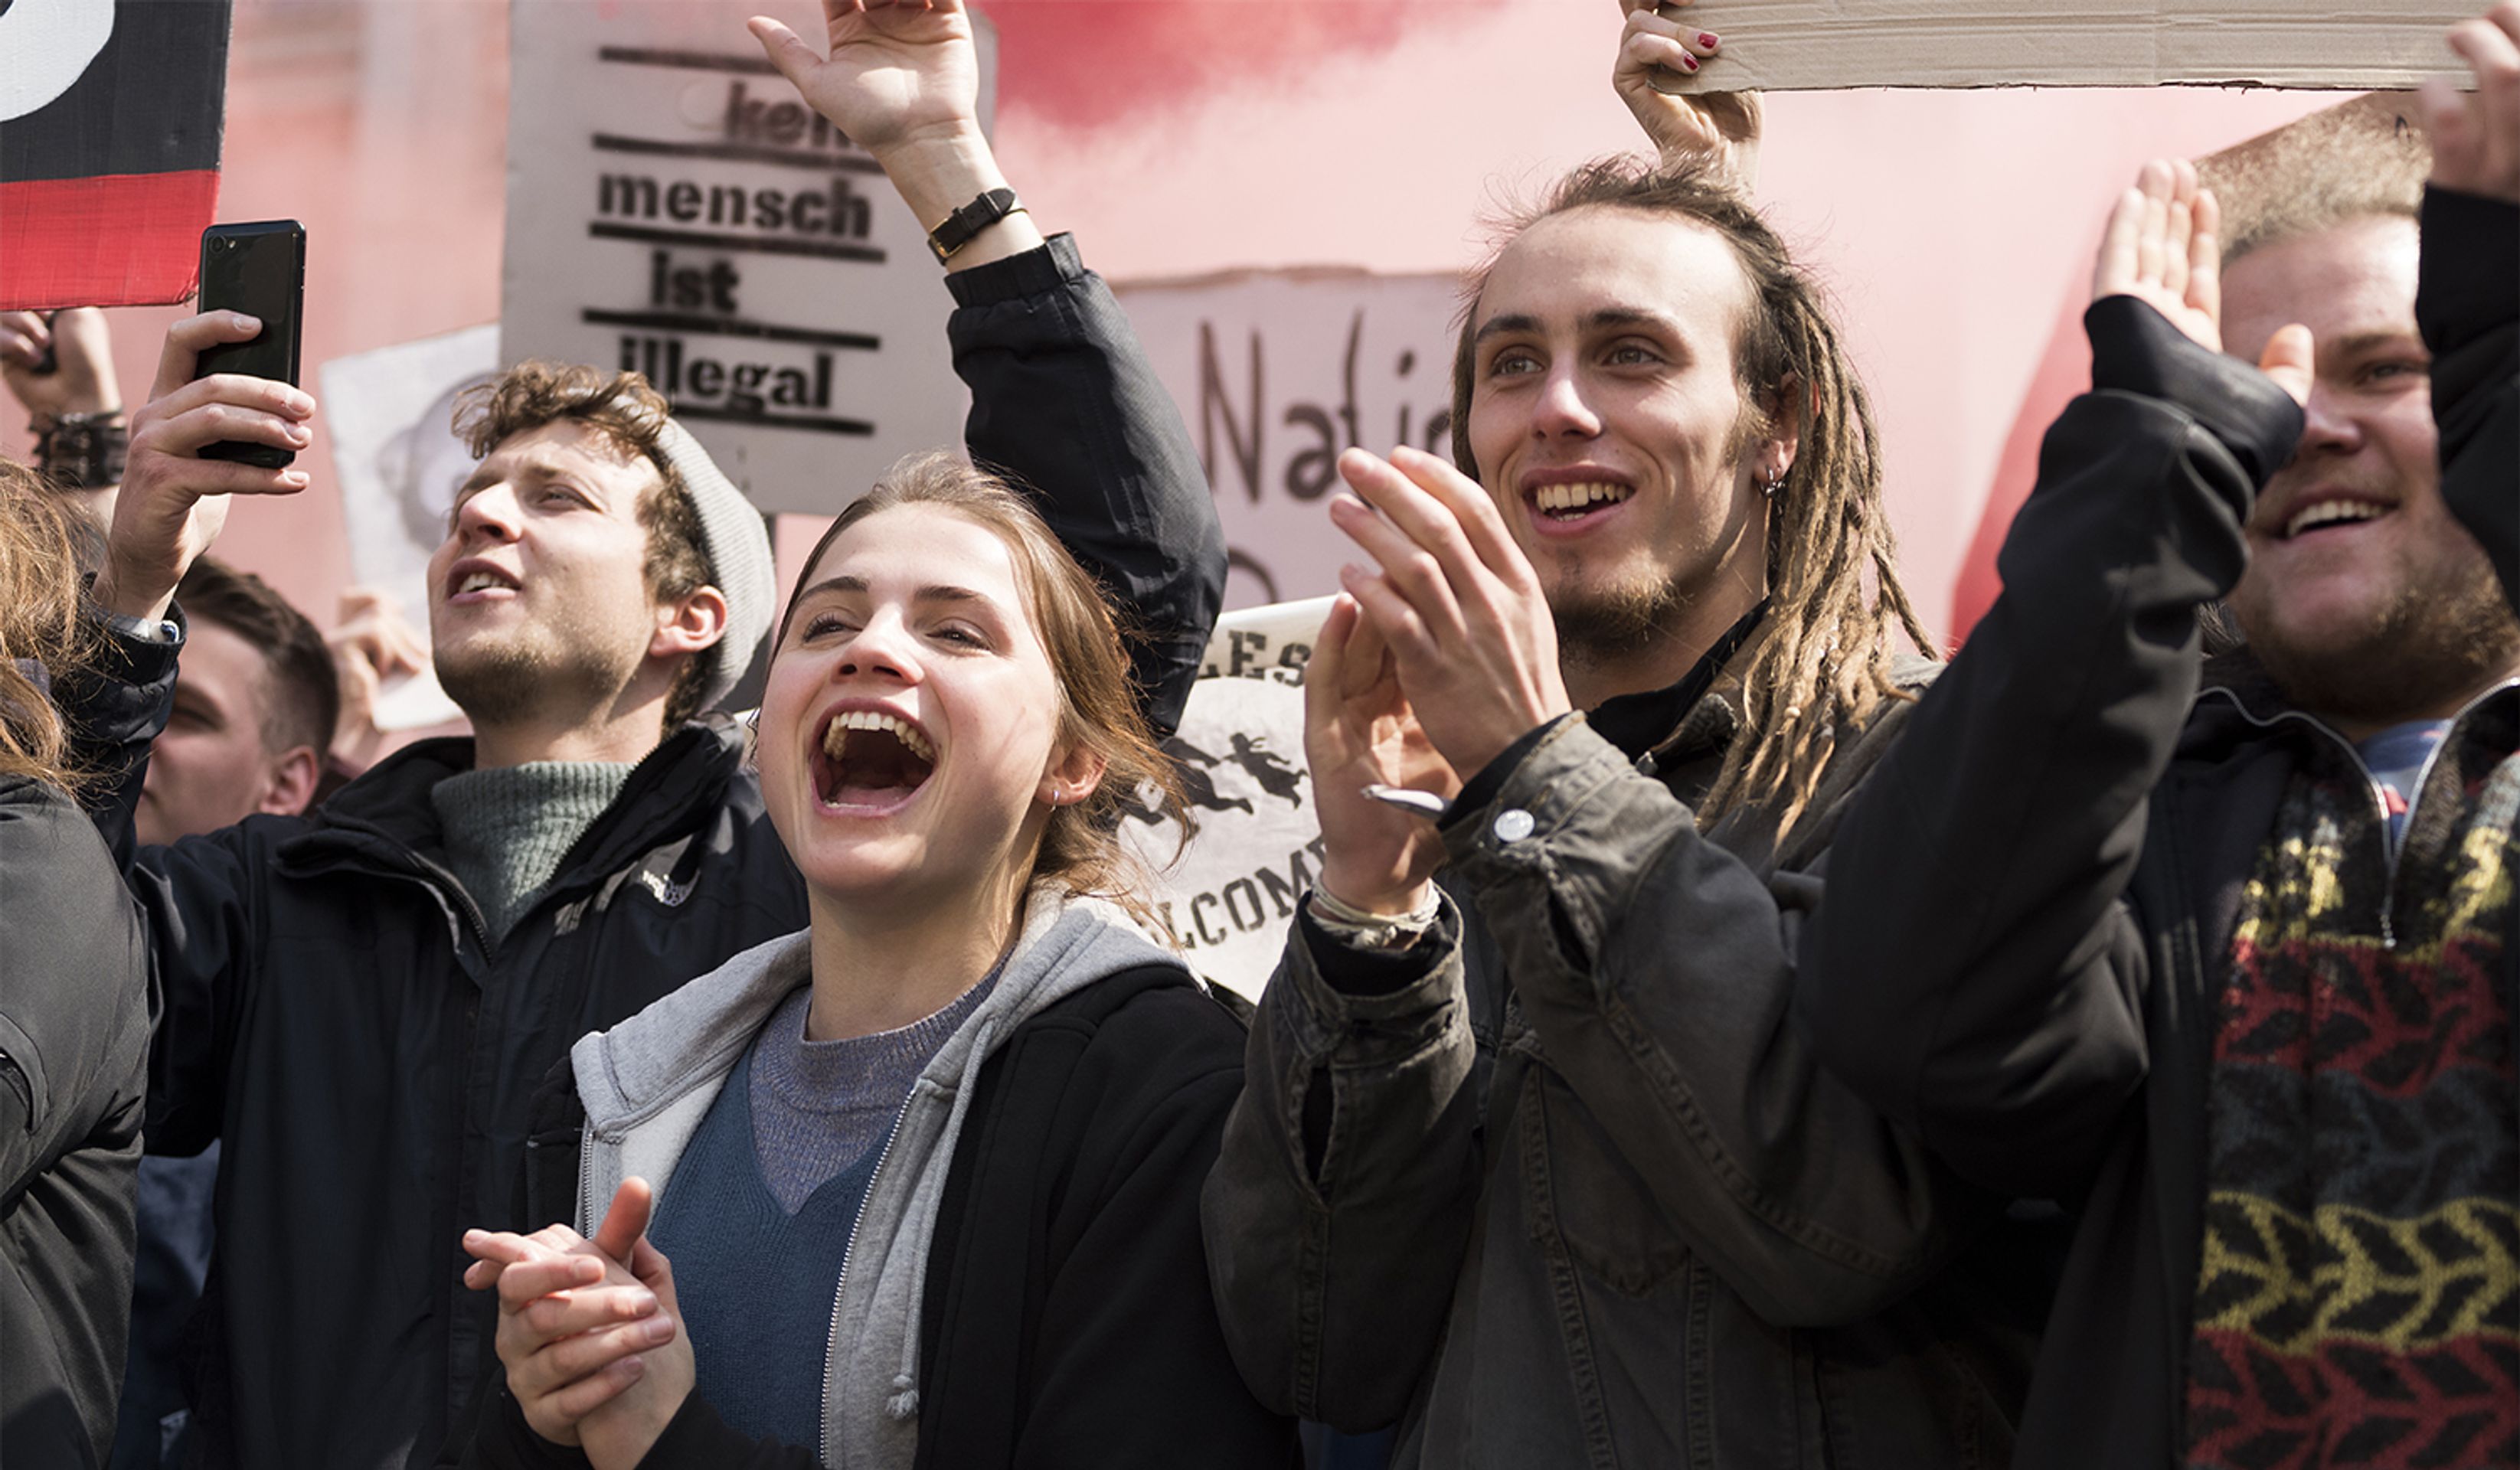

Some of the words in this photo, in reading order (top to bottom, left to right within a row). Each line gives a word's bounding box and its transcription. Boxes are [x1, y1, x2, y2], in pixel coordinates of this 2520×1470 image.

[726, 80, 851, 148] kei
[597, 172, 872, 239] mensch
[650, 249, 740, 314] ist
[620, 335, 833, 412] illegal
[1129, 835, 1326, 949] LCOM
